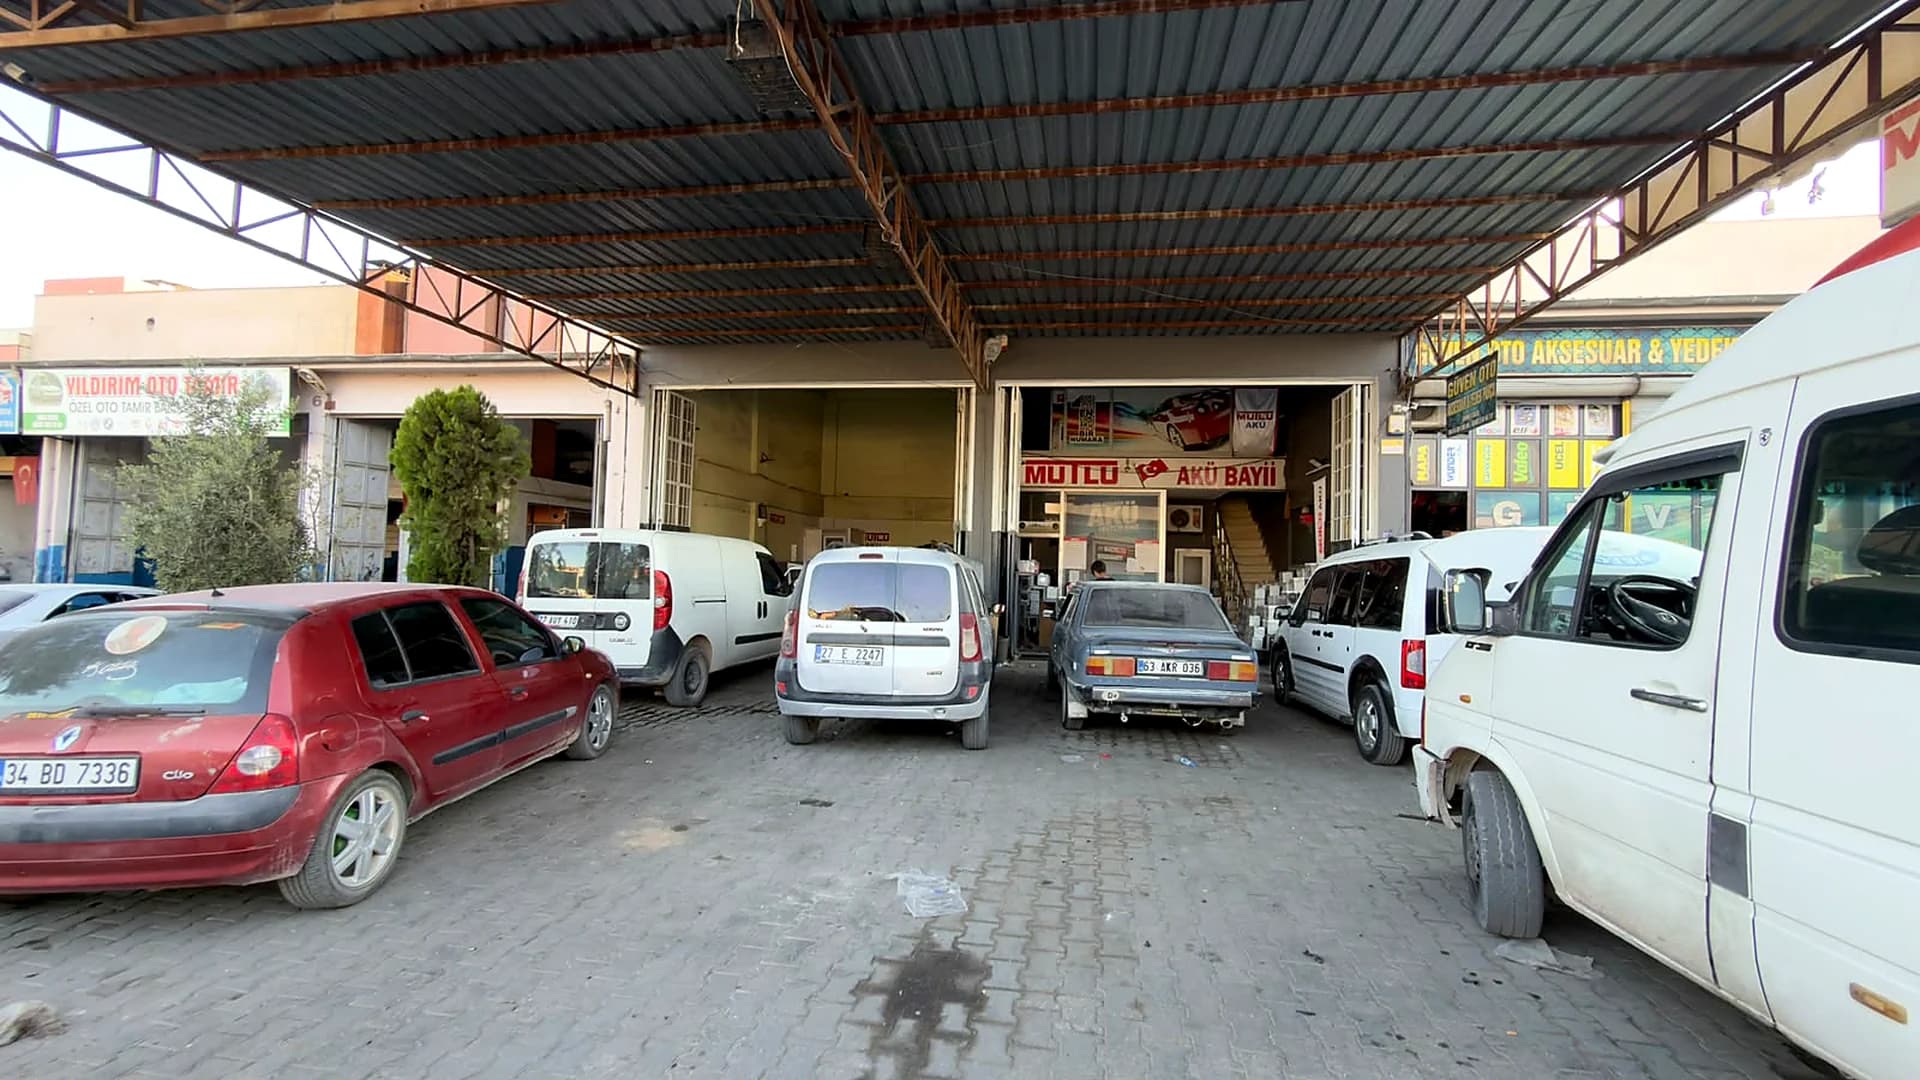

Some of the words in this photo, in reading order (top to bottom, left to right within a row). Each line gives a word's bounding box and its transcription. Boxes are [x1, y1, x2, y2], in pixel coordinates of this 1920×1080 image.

[1532, 338, 1641, 365] AKSESUAR
[1648, 338, 1663, 364] &
[66, 374, 140, 396] YILDIRIM
[148, 374, 178, 396] OTO
[96, 401, 118, 413] OTO
[1024, 460, 1118, 485] MUTLU
[1177, 461, 1217, 486] AKÜ
[822, 647, 833, 658] 27
[841, 648, 848, 659] E
[856, 648, 880, 660] 2247
[1144, 662, 1155, 672] 63
[1160, 661, 1178, 673] AKR
[1183, 662, 1200, 673] 036
[5, 763, 28, 784] 34
[40, 763, 65, 784] BD
[76, 762, 130, 784] 7336
